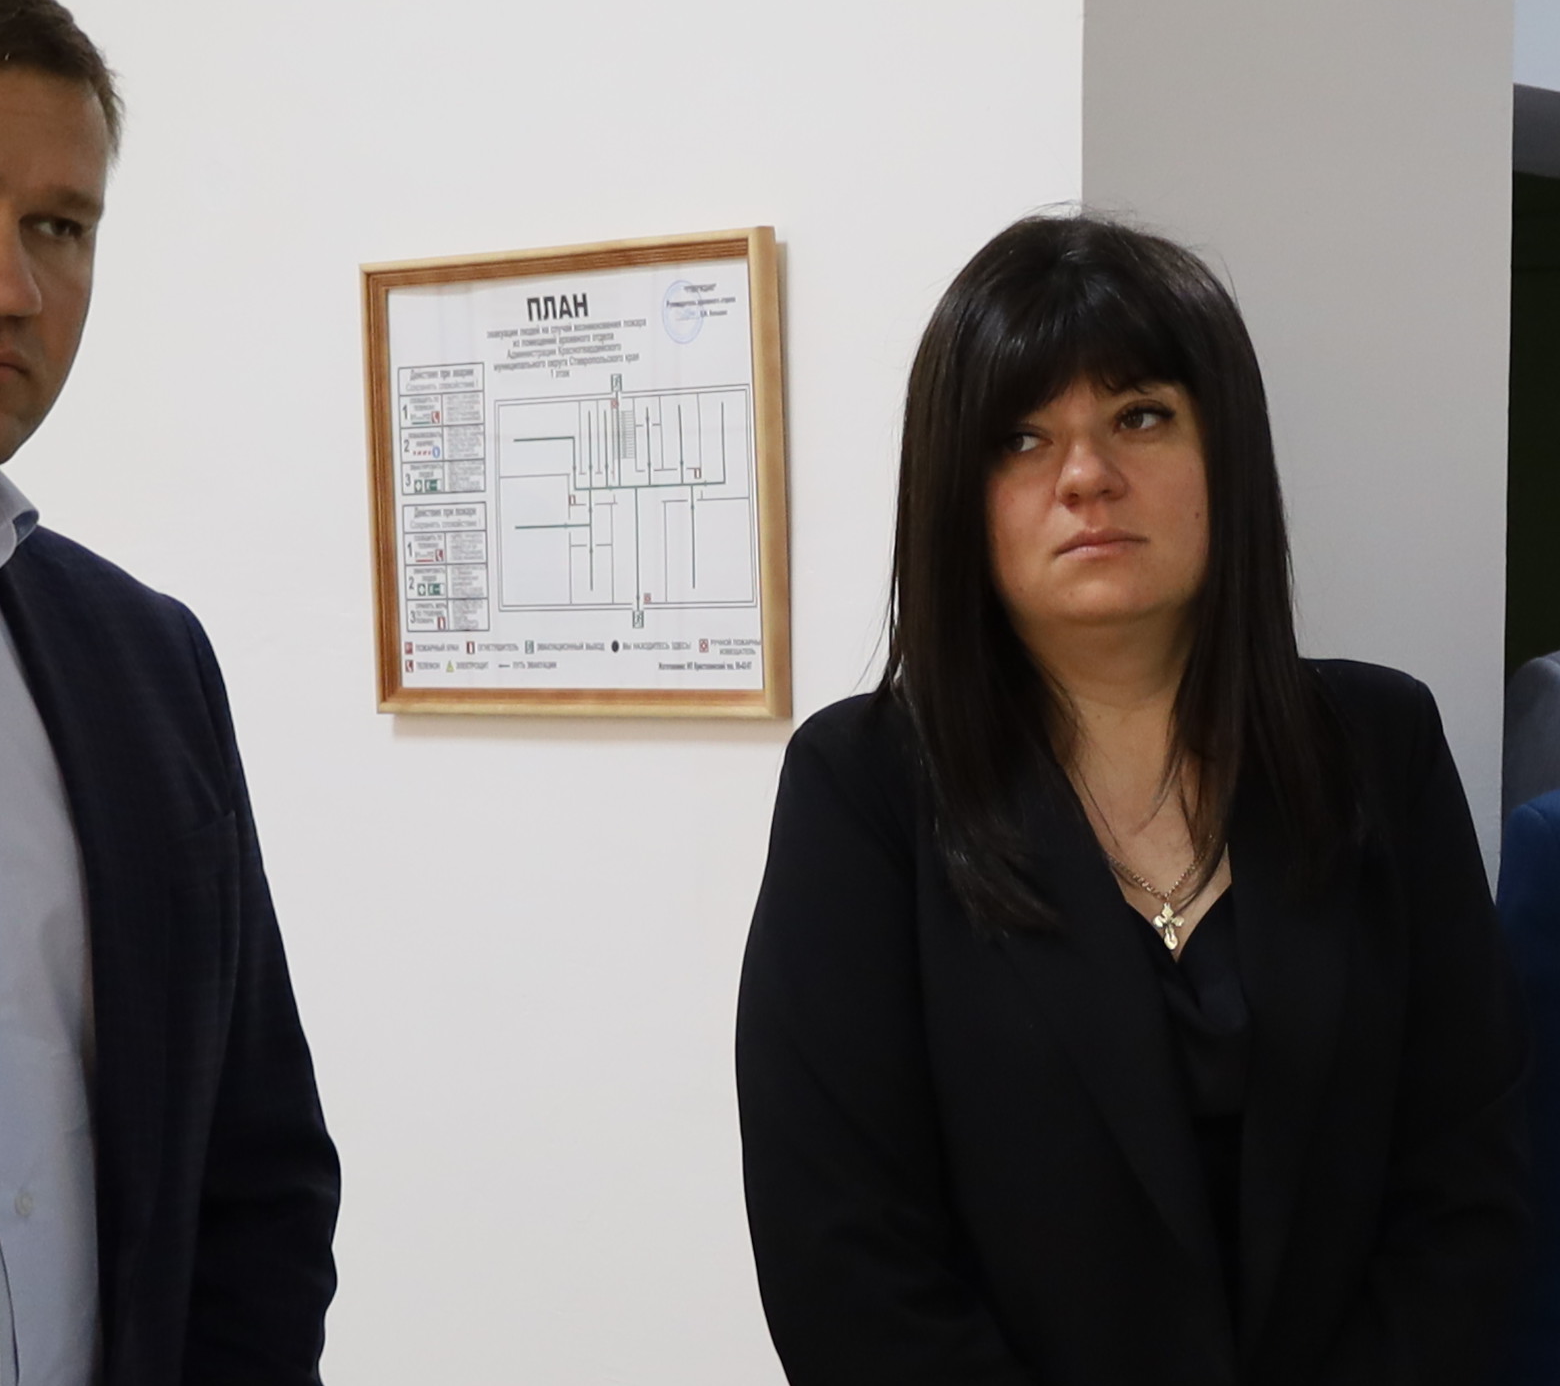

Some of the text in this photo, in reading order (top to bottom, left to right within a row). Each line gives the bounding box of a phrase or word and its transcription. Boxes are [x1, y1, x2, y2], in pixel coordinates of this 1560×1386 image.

[527, 293, 588, 322] ПЛАН
[402, 404, 408, 420] 1
[403, 439, 410, 453] 2
[405, 473, 411, 487] 3
[407, 541, 413, 557] 1
[409, 576, 415, 590] 2
[410, 610, 416, 624] 3
